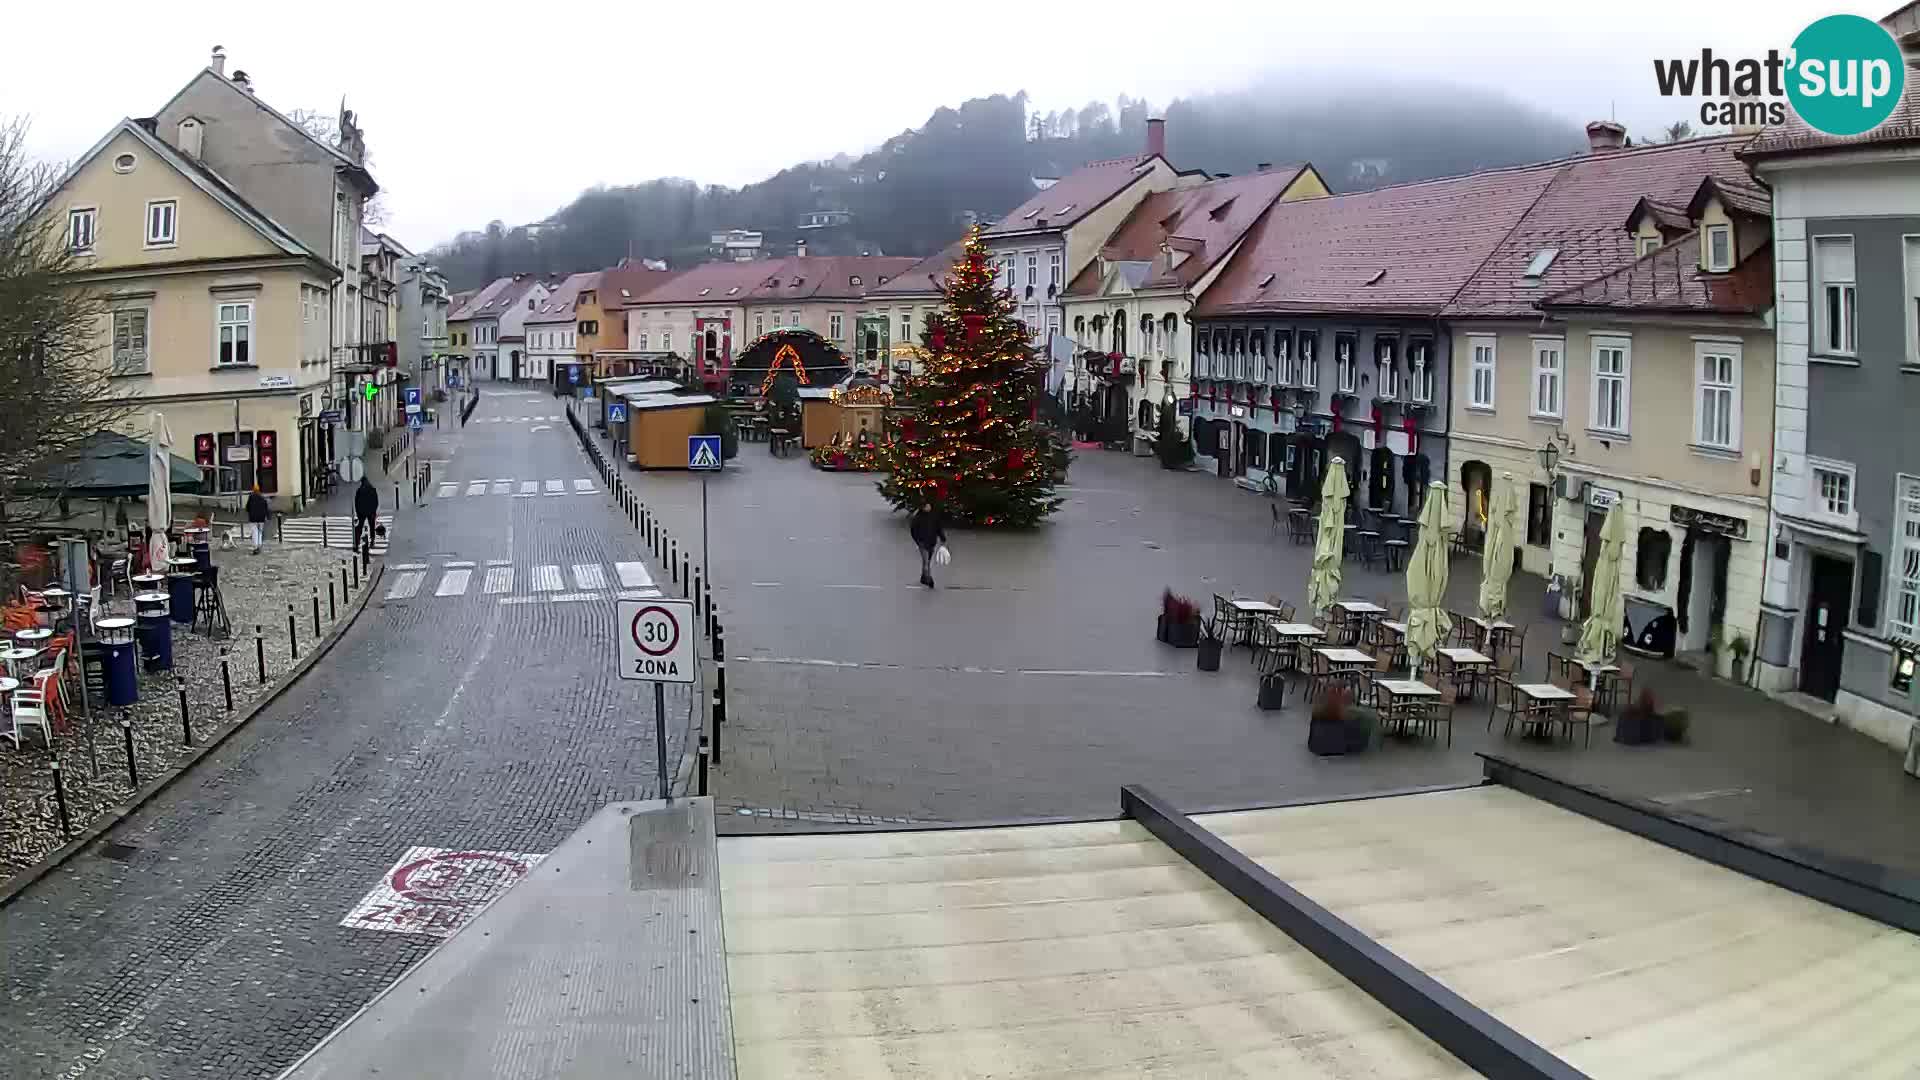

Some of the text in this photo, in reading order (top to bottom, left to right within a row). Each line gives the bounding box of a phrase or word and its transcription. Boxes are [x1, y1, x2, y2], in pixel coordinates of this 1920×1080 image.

[410, 391, 417, 403] P
[644, 621, 668, 643] 30
[634, 659, 679, 675] ZONA
